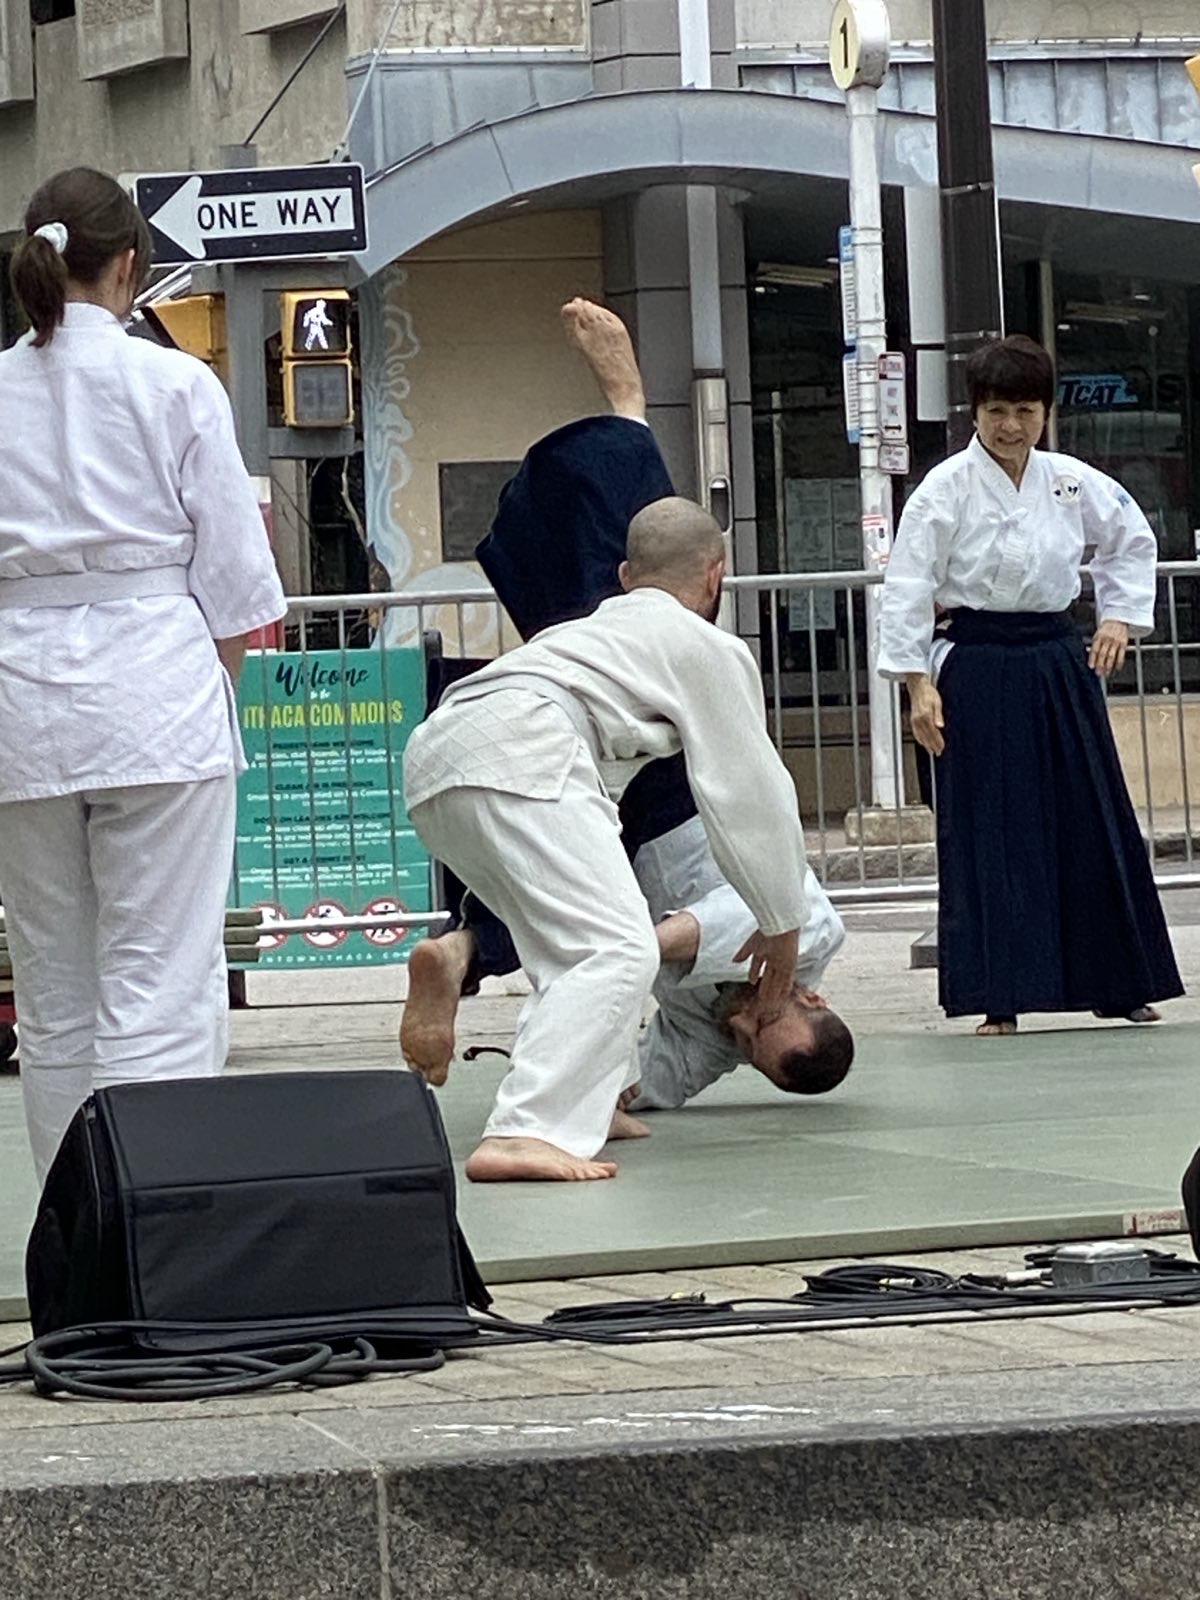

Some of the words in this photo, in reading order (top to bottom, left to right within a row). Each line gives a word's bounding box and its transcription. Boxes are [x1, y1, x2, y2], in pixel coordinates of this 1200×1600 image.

[839, 17, 849, 69] 1
[197, 201, 258, 231] ONE
[277, 195, 341, 226] WAY
[1058, 379, 1123, 409] TCAT
